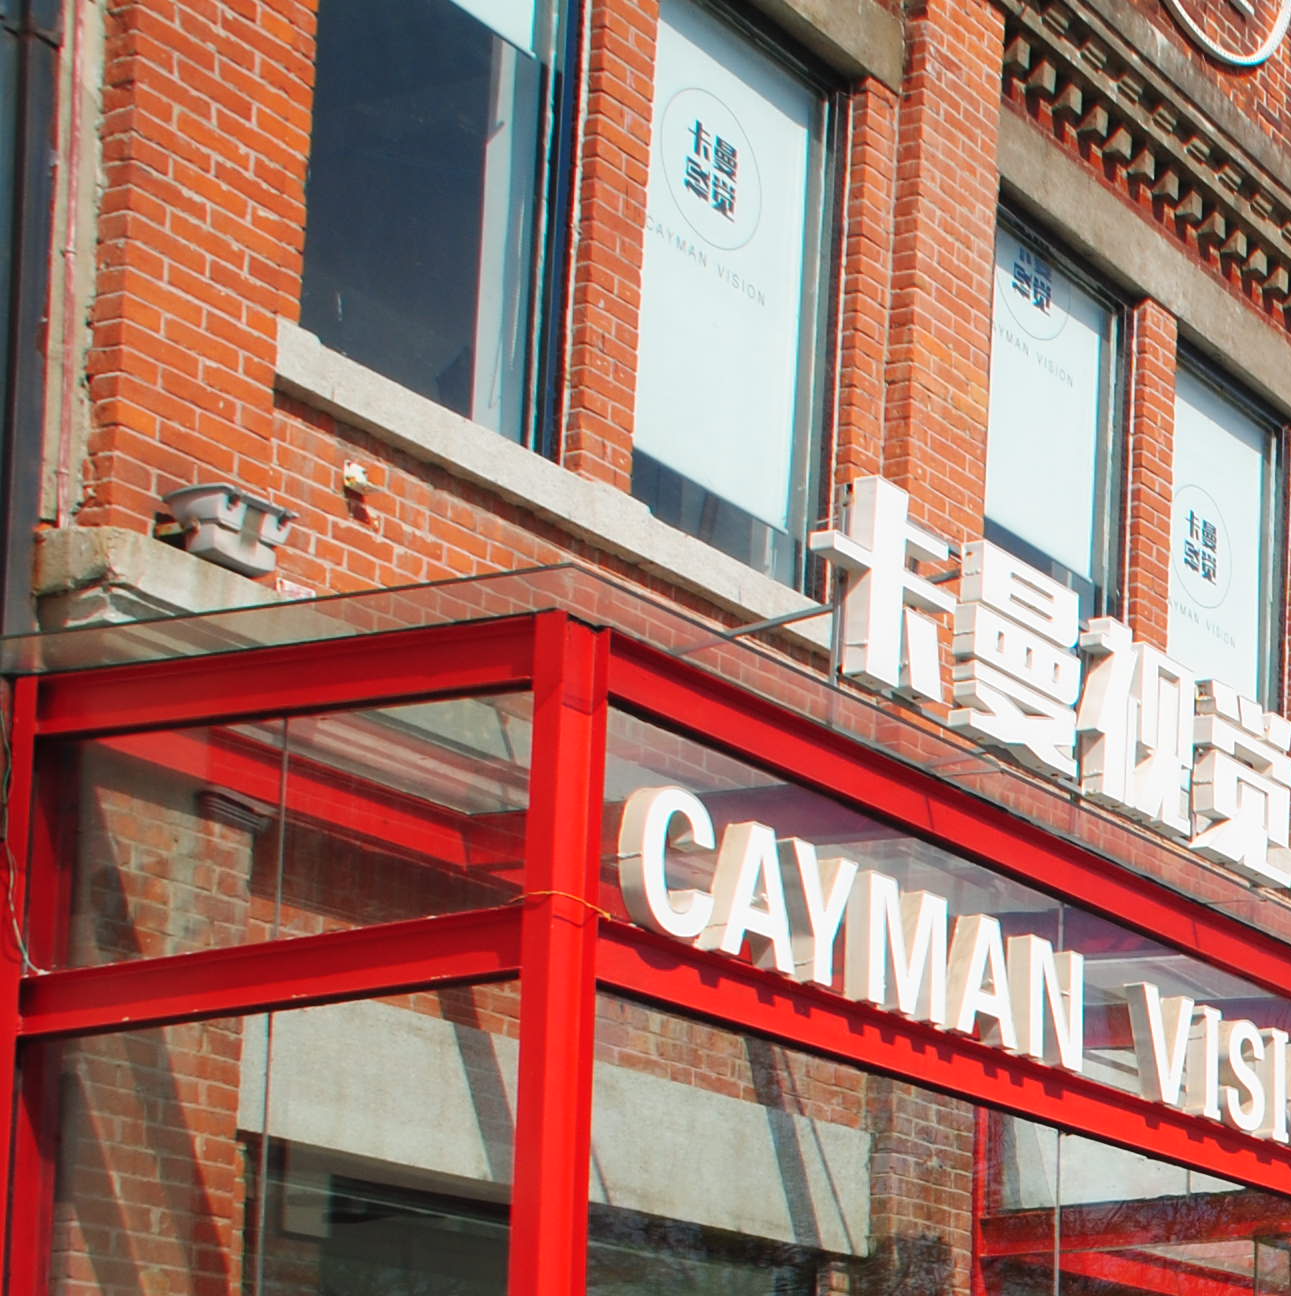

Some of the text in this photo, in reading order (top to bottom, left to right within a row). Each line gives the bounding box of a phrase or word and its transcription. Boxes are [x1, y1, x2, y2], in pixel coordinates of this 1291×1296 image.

[646, 215, 766, 307] CAYMAN VISION
[1036, 351, 1074, 388] VISION
[620, 785, 1084, 1073] CAYMAN
